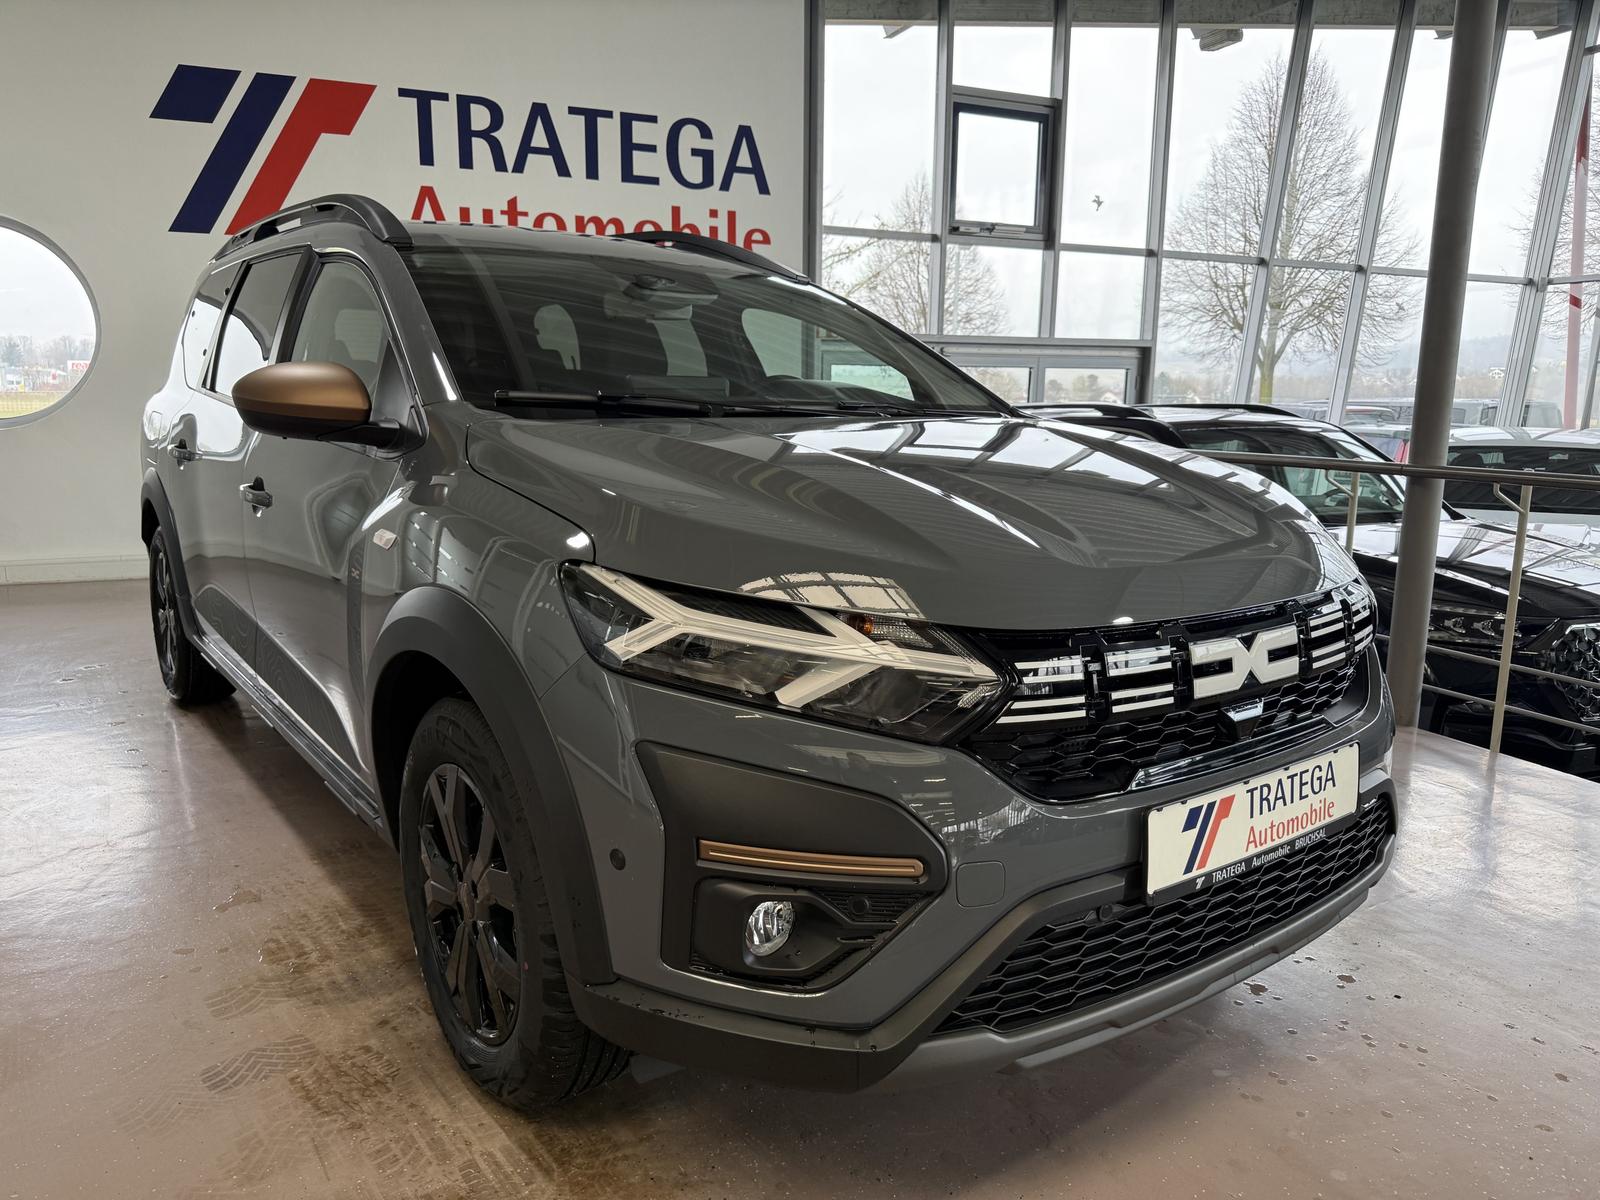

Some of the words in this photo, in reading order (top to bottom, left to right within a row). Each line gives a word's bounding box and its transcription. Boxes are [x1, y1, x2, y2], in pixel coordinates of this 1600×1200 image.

[397, 87, 771, 196] TRATEGA
[71, 362, 90, 370] rea
[1246, 760, 1336, 819] TRATEGA
[1245, 797, 1335, 852] Automobile
[1212, 862, 1246, 883] TRATEGA
[1251, 844, 1291, 868] Automobile
[1294, 827, 1327, 850] BRUCHSAL
